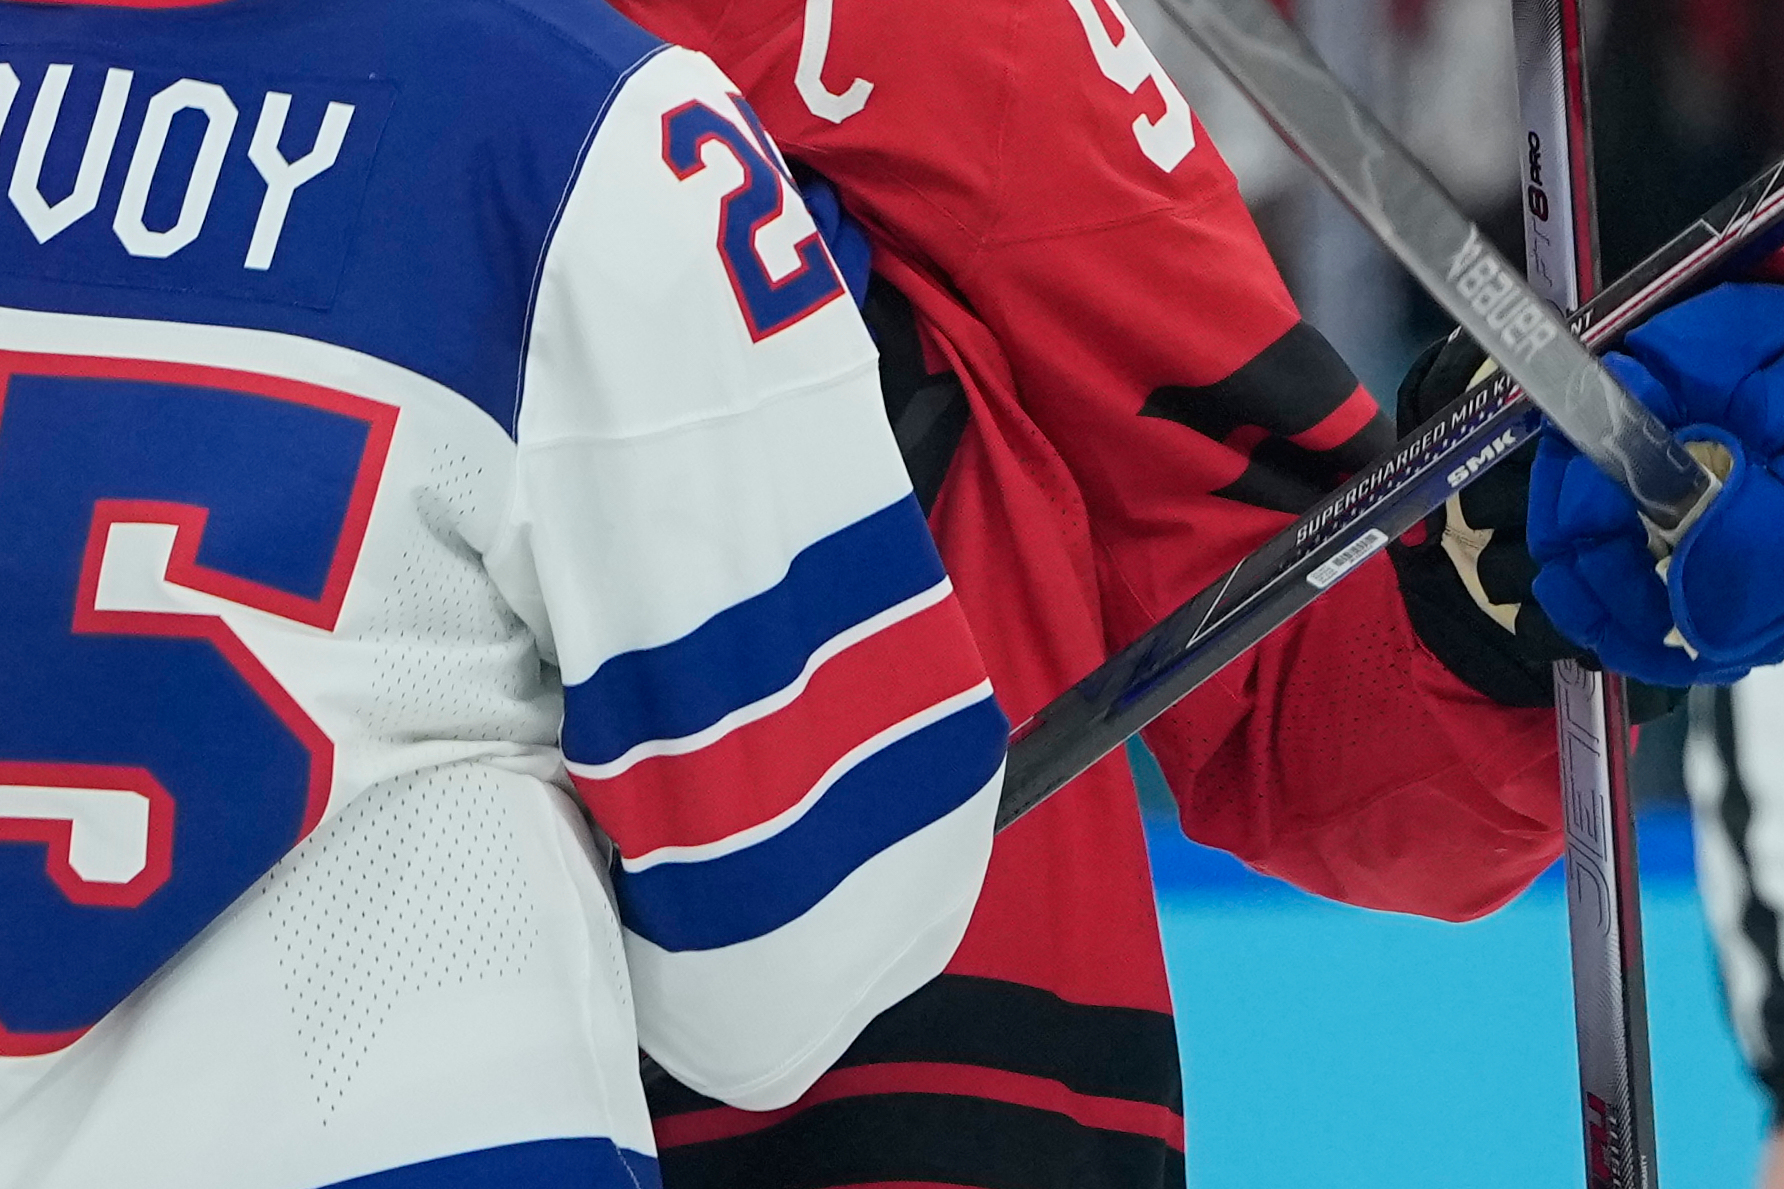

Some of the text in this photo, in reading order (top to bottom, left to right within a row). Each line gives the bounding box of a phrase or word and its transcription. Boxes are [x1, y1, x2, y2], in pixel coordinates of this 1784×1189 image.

[0, 63, 355, 271] VOY
[661, 91, 846, 343] 2
[1296, 422, 1445, 544] SUPERCHARGED
[1451, 390, 1488, 427] MID
[1445, 427, 1519, 489] SMK
